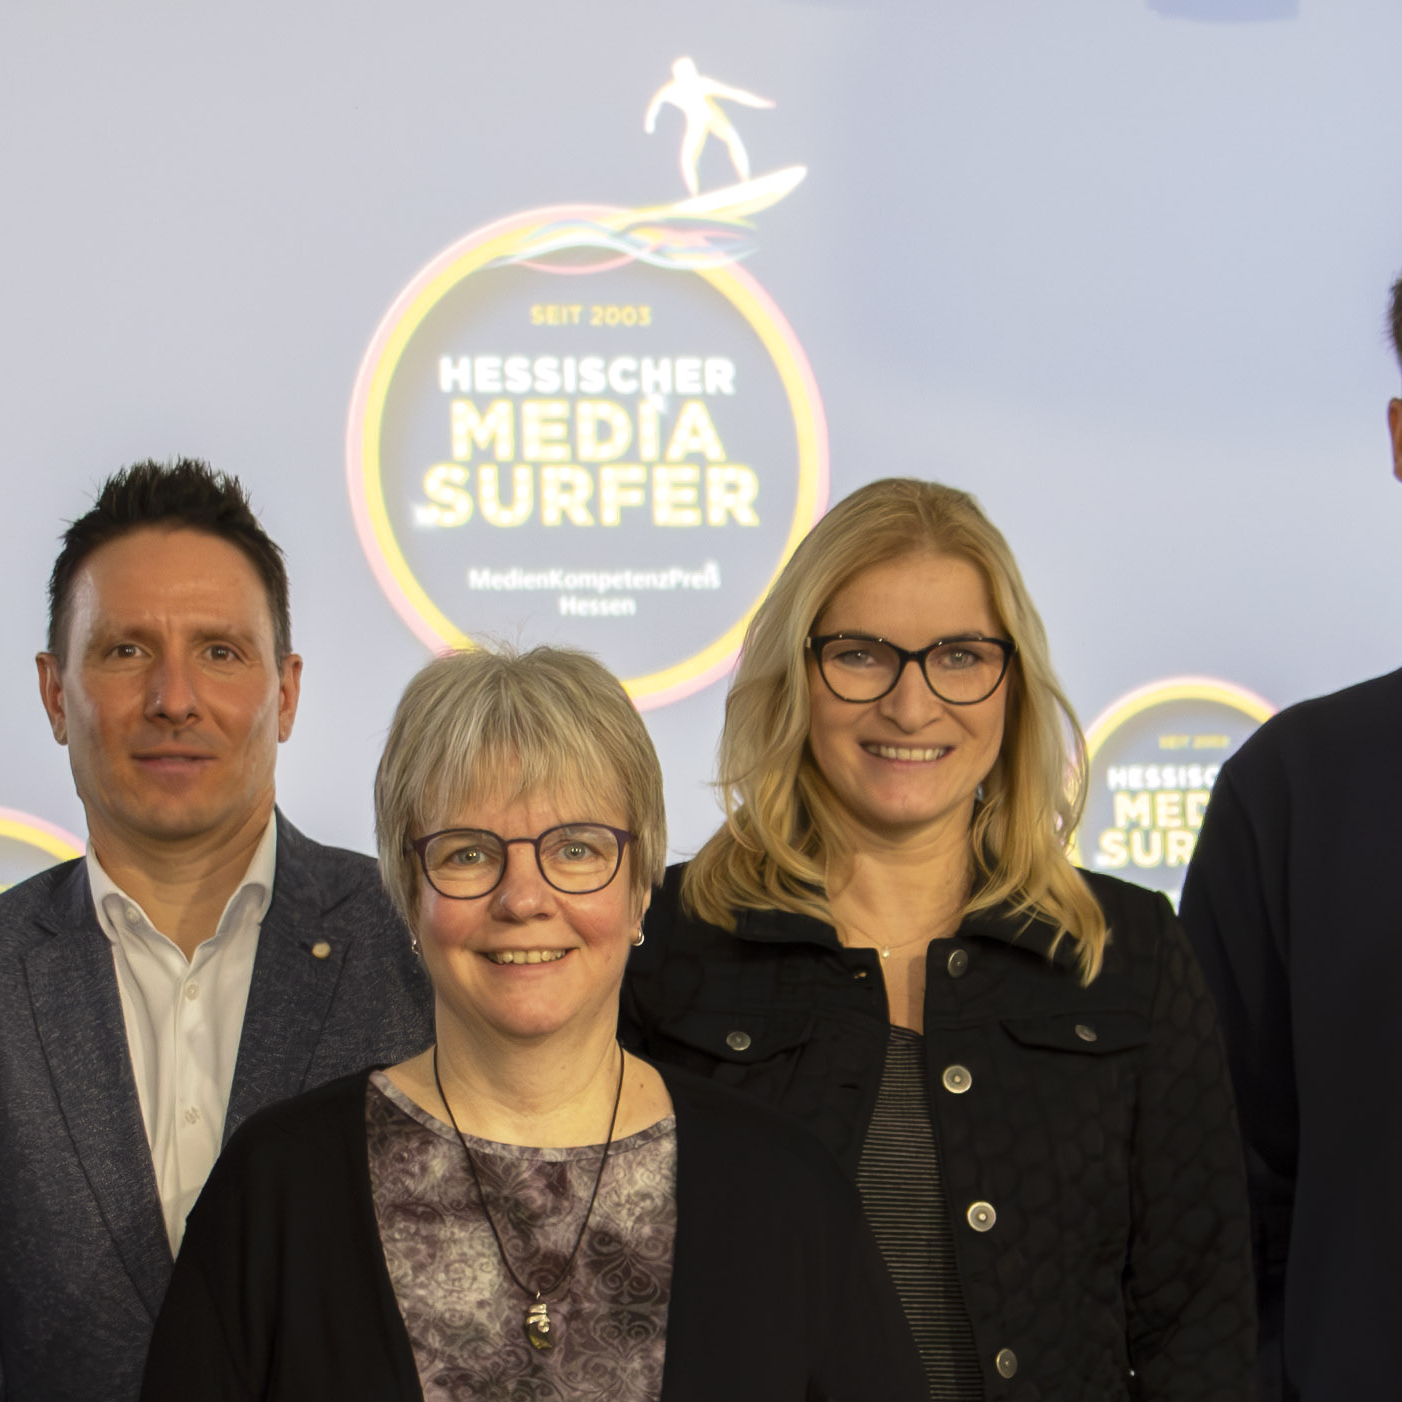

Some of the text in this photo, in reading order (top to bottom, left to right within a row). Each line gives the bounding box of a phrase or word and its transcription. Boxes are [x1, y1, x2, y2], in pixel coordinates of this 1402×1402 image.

[530, 305, 652, 327] SEIT 2003
[439, 356, 736, 394] HESSISCHER
[451, 398, 727, 462] MEDIA
[421, 463, 761, 528] SURFER
[559, 597, 636, 617] Hessen
[1098, 829, 1196, 868] SUR
